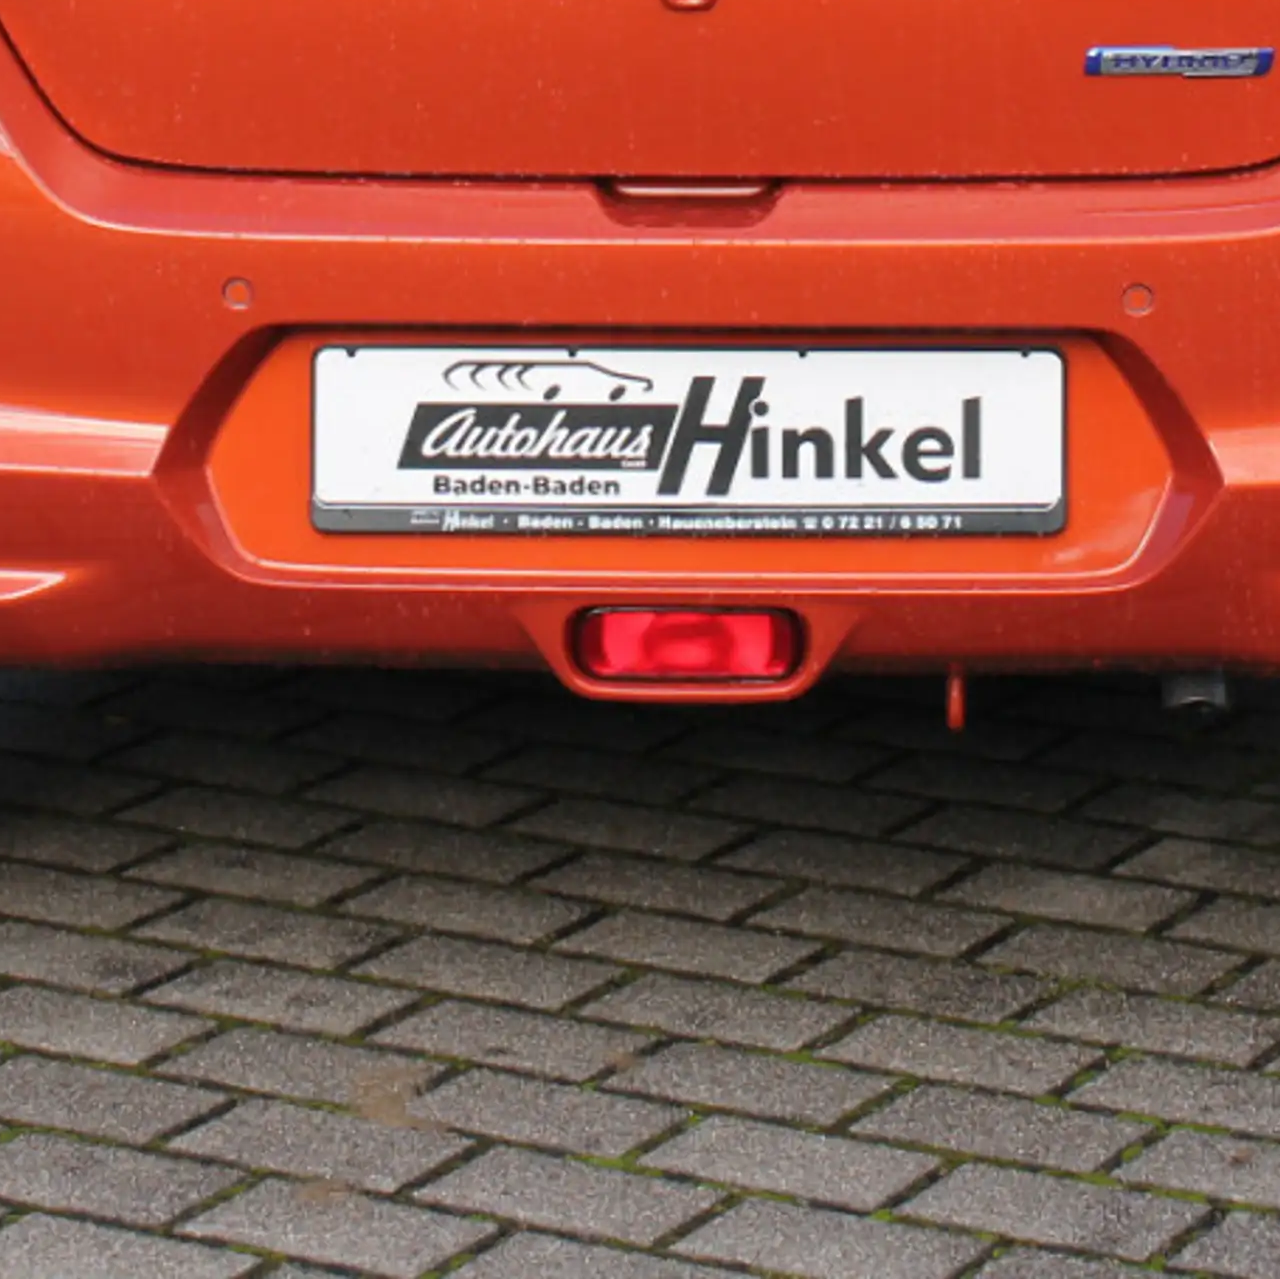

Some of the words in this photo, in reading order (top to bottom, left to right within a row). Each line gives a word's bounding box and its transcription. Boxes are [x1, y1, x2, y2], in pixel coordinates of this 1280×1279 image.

[421, 407, 653, 459] Autohaus
[656, 376, 981, 495] Hinkel
[433, 474, 621, 496] Baden-Baden
